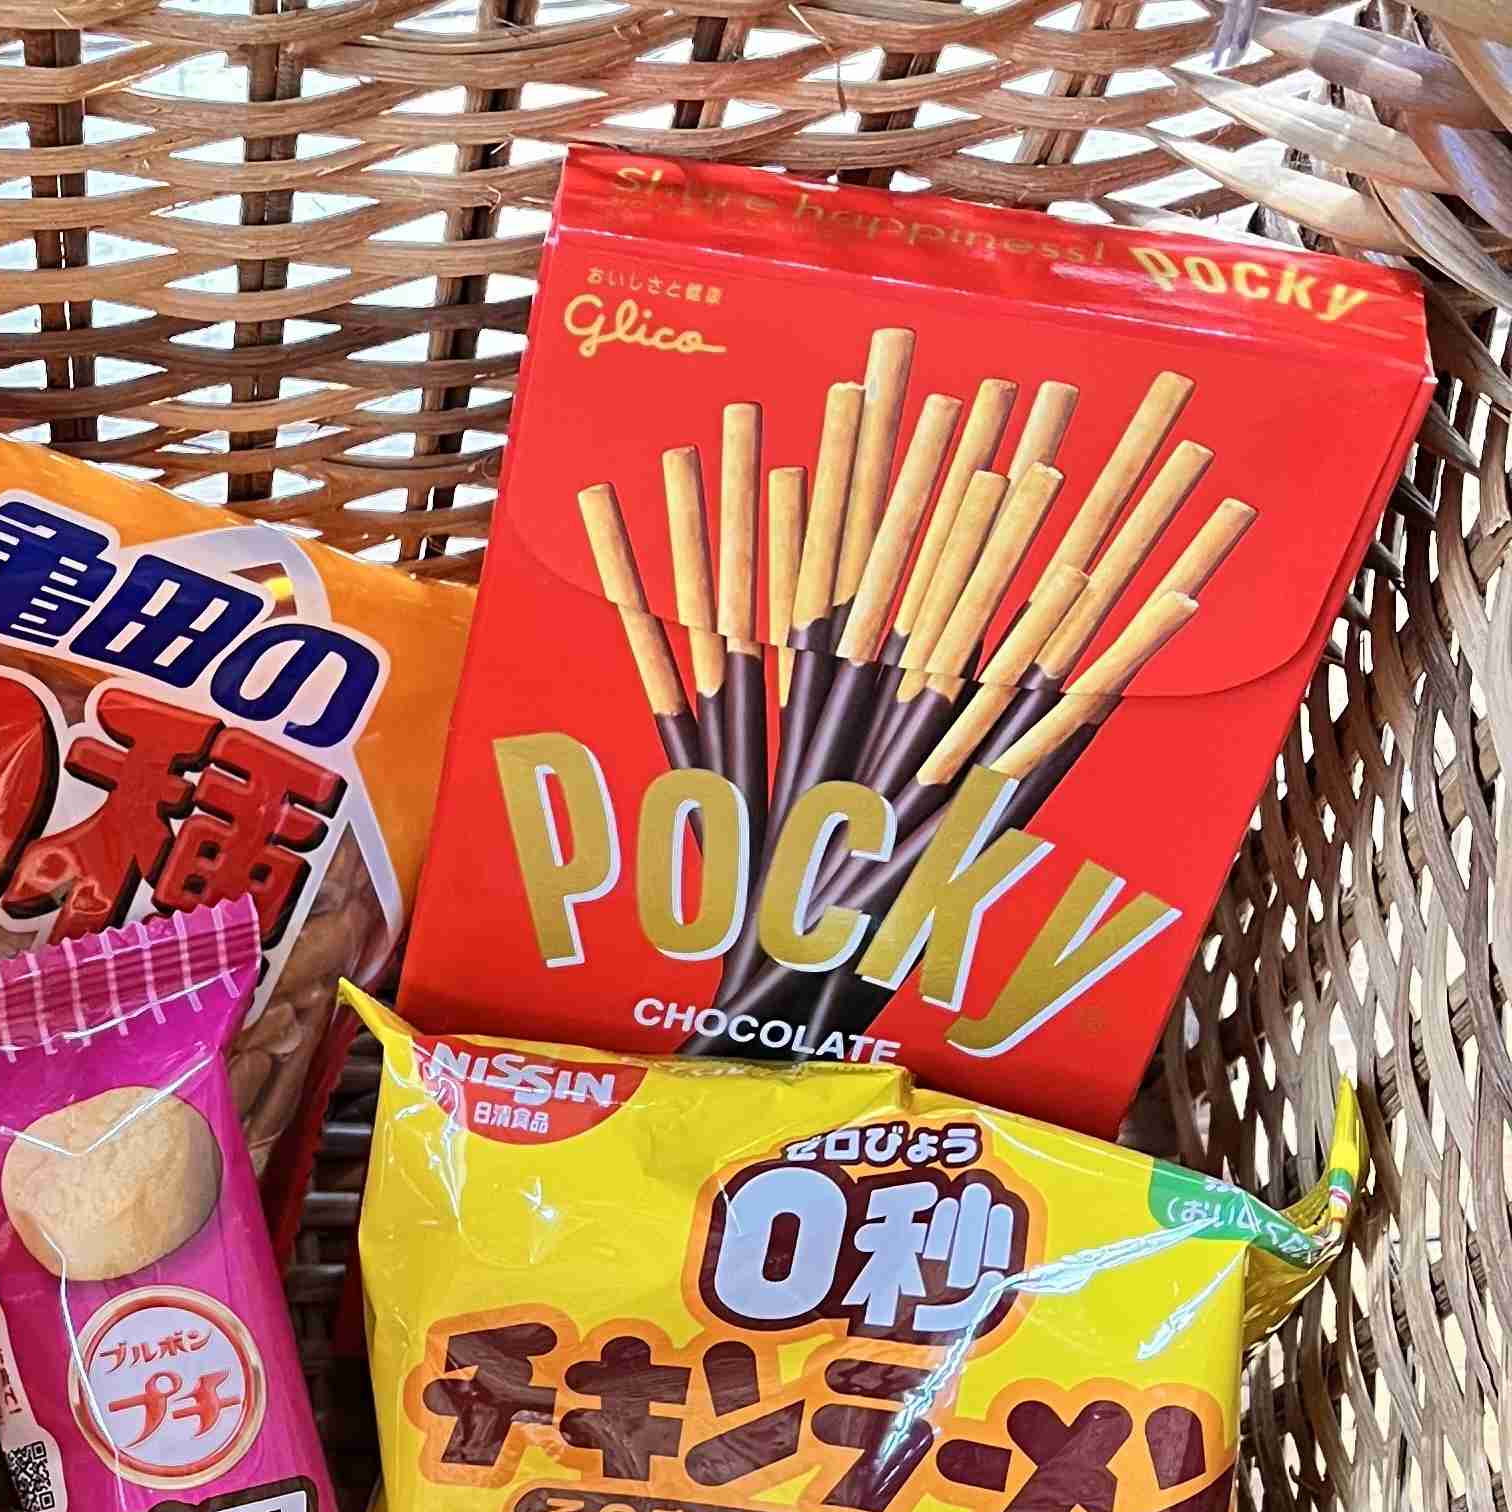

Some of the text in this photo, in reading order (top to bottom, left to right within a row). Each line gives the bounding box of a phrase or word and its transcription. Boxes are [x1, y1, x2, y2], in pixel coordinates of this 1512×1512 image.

[564, 294, 727, 358] Glico
[633, 997, 902, 1066] CHOCOLATE
[429, 1041, 617, 1108] NISSIN
[472, 1102, 551, 1135] 日清食品
[714, 1166, 1015, 1333] 0秒
[99, 1328, 212, 1374] ブルボン
[108, 1368, 242, 1448] プチ
